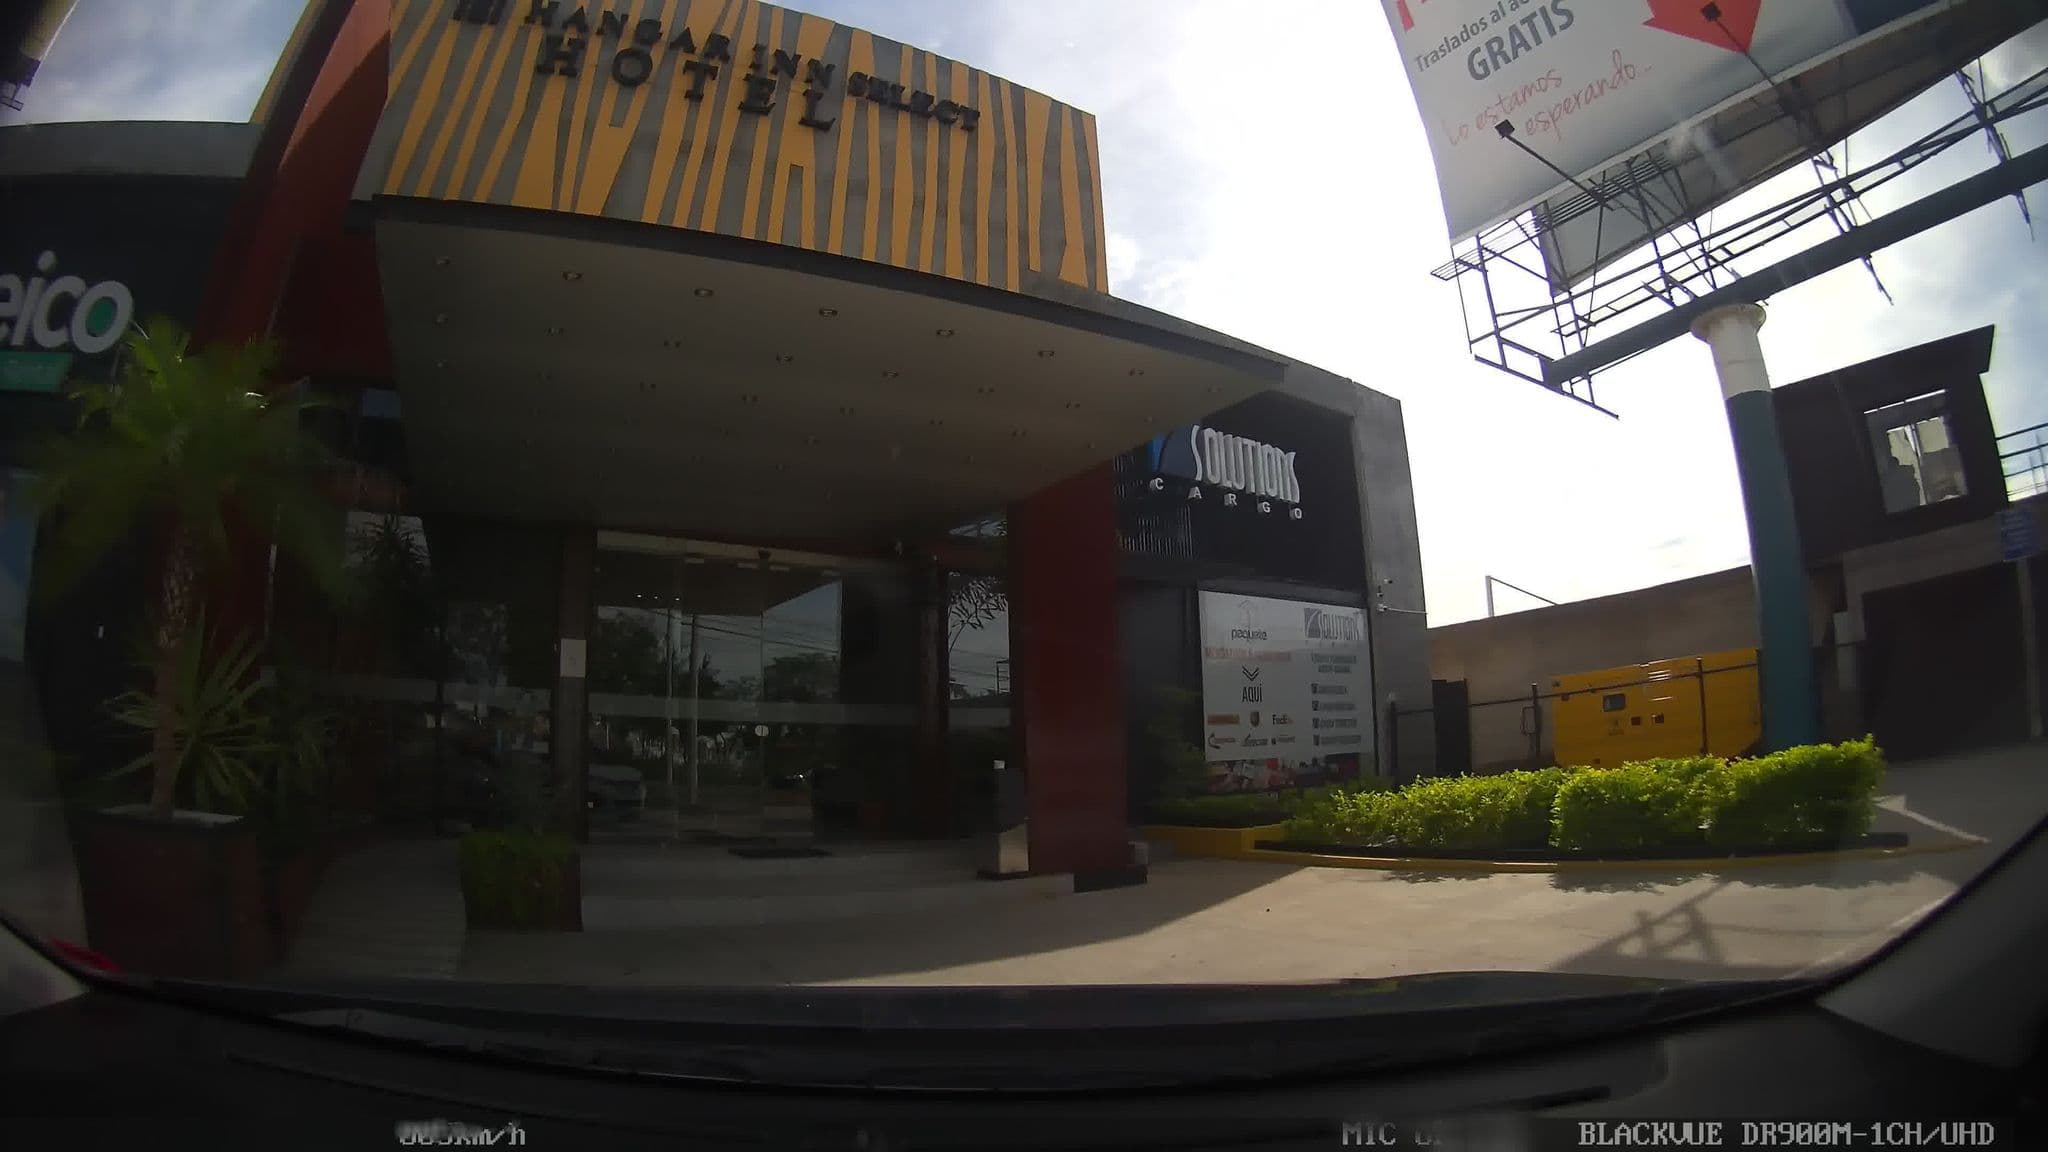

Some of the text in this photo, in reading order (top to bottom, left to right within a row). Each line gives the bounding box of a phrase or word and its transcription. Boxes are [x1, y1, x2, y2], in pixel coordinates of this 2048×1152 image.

[525, 0, 980, 131] HANGAR INN SELECT
[1414, 15, 1488, 72] Traslados
[1489, 1, 1506, 24] al
[1467, 0, 1575, 81] GRATIS
[537, 33, 836, 131] HOTEL
[1476, 68, 1562, 129] estamos
[1150, 477, 1303, 519] CARGO
